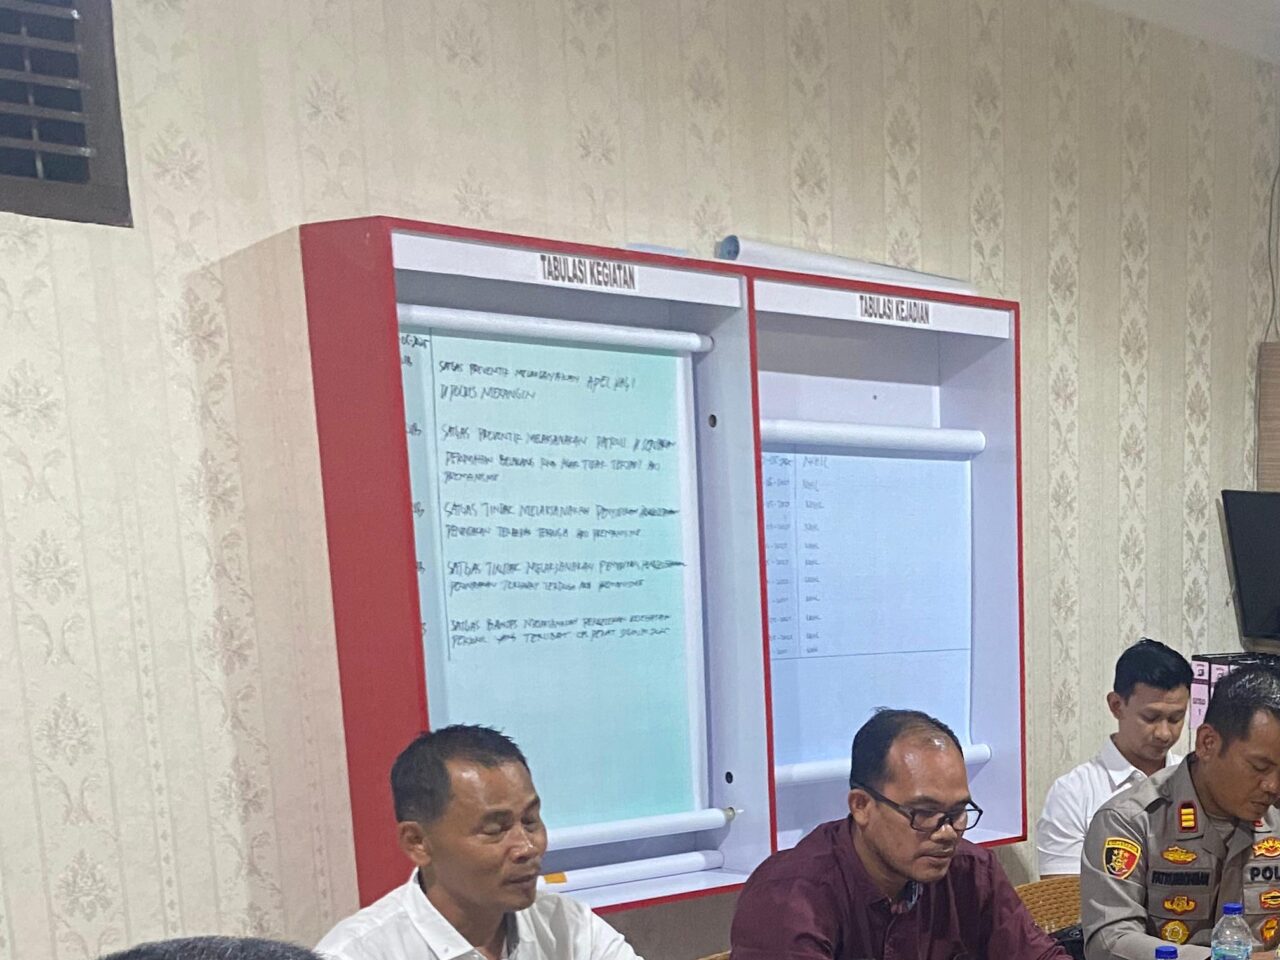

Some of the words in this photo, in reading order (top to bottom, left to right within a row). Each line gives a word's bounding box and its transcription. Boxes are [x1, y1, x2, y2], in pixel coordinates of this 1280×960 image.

[540, 254, 587, 285] TABULASI
[589, 260, 636, 290] KEGIATAN
[859, 294, 894, 321] TABULASI
[895, 299, 930, 325] KEJADIAN
